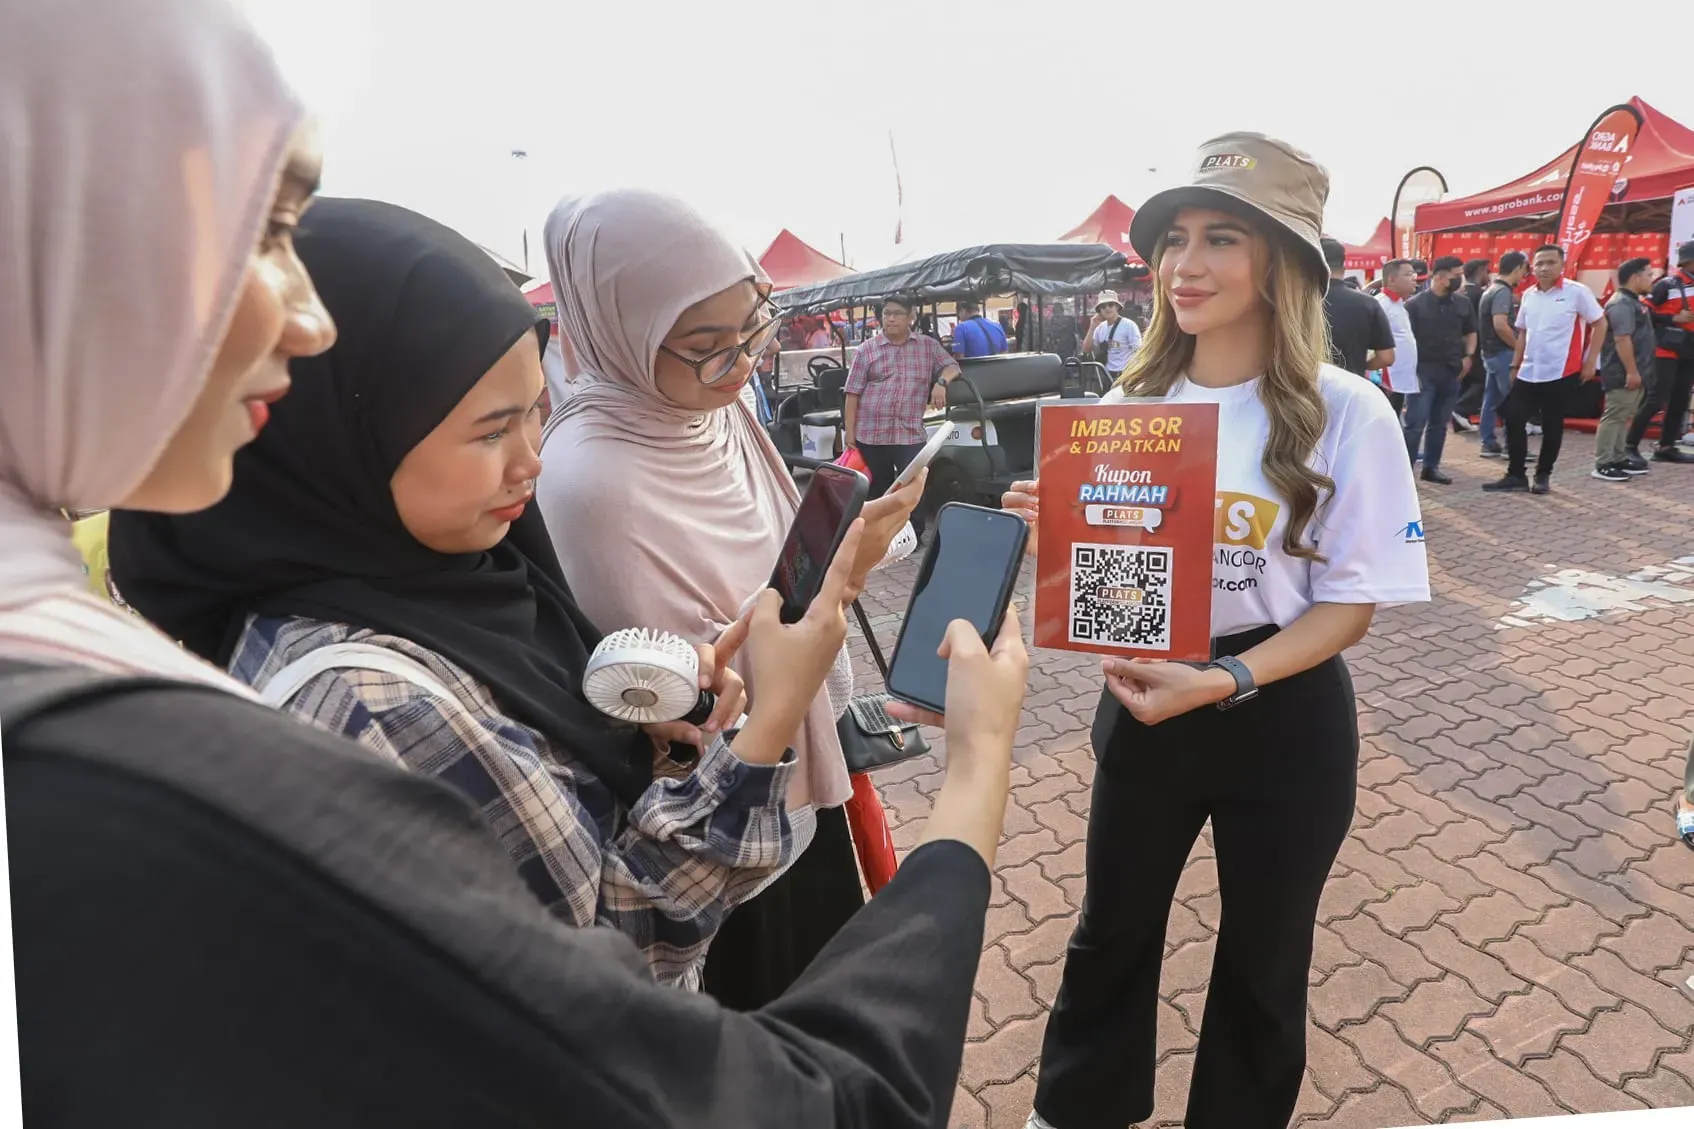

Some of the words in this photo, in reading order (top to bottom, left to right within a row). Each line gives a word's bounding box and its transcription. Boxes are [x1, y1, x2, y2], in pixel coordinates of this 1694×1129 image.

[1206, 155, 1250, 167] PLATS
[1070, 418, 1143, 437] IMBAS
[1149, 416, 1183, 437] QR
[1069, 441, 1081, 454] &
[1086, 439, 1181, 453] DAPATKAN
[1094, 463, 1152, 486] Kupon
[1079, 485, 1168, 503] RAHMAH
[1106, 509, 1140, 519] PLATS
[1102, 588, 1137, 600] PLATS
